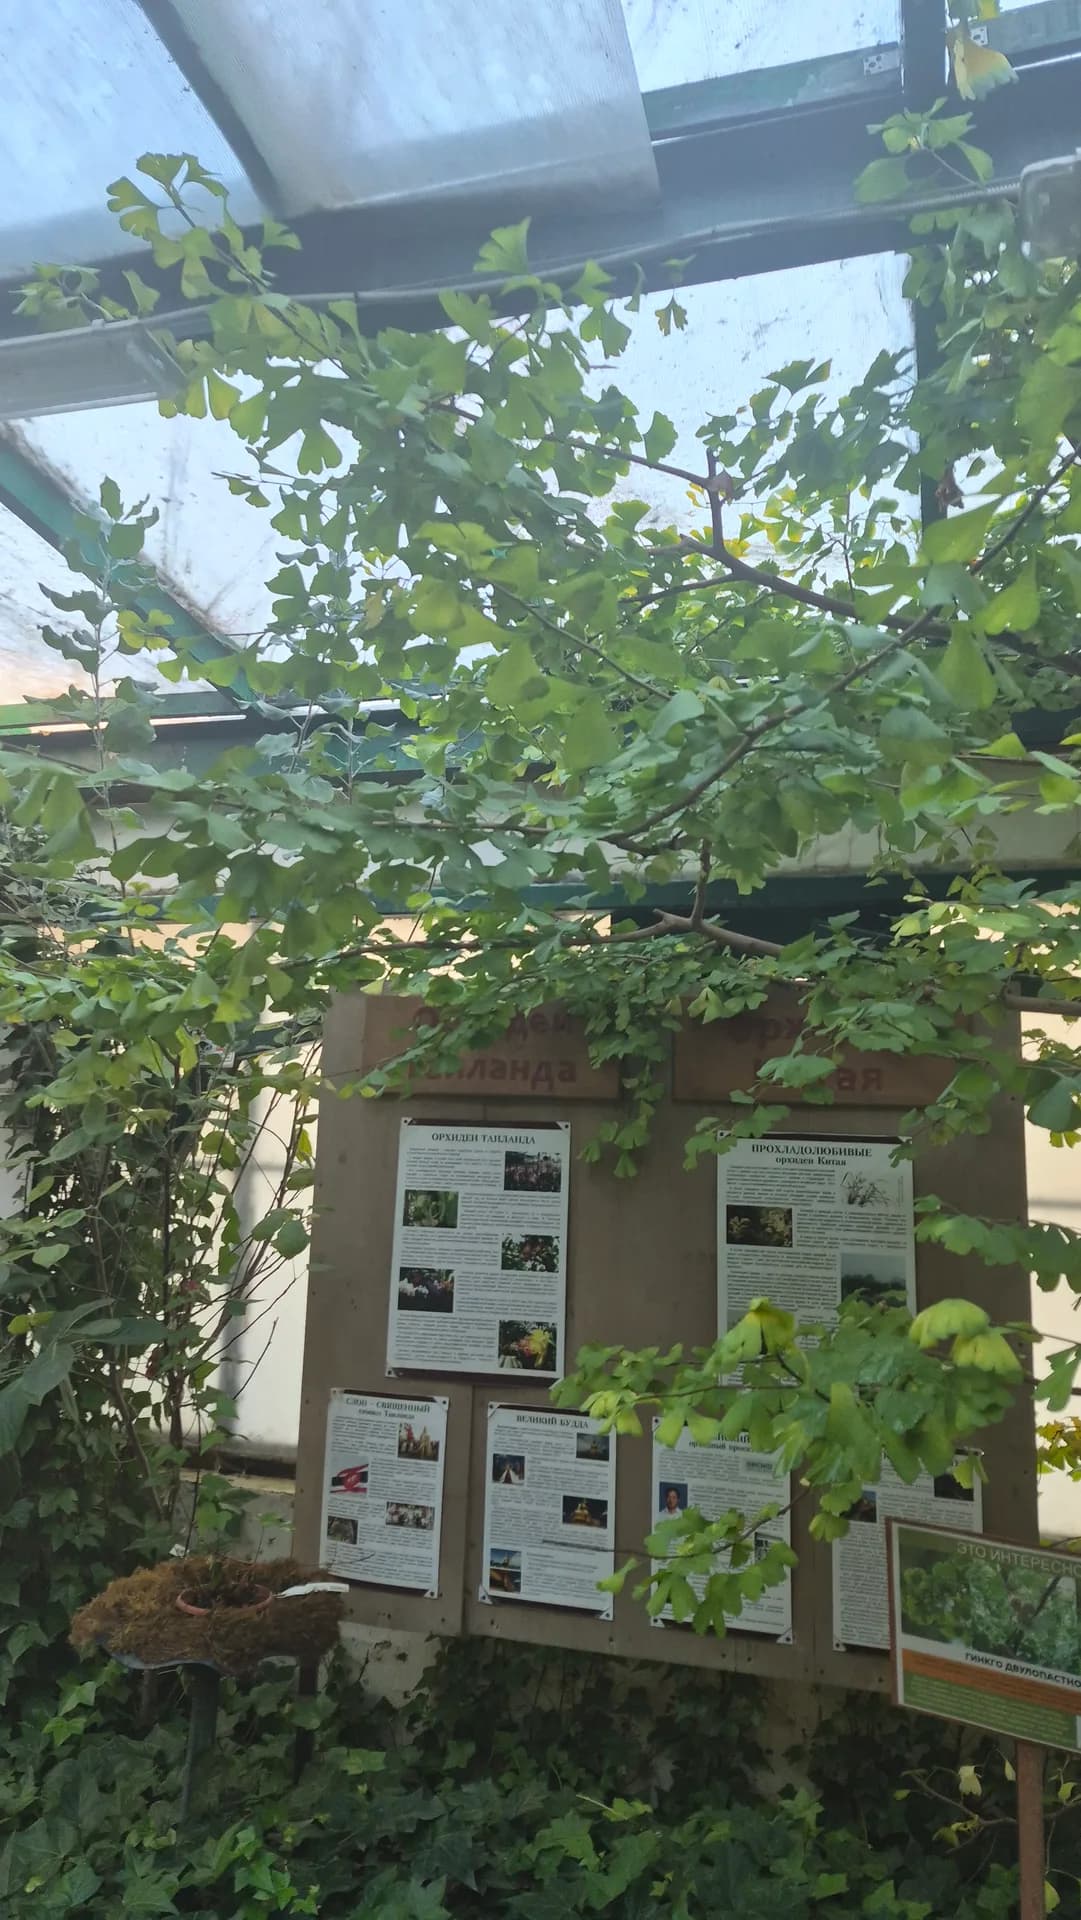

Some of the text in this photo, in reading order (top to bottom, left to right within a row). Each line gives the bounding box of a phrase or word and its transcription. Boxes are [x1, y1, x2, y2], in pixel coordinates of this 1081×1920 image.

[431, 1132, 479, 1143] ОРХИДЕИ
[751, 1143, 873, 1157] ПРОХЛАДОЛЮБИВЫЕ
[775, 1156, 847, 1166] орхидеи Китая
[516, 1415, 589, 1429] ВЕЛИКИЙ БУДДА
[956, 1542, 987, 1558] ЭТО
[965, 1652, 1004, 1669] ГИНКГО
